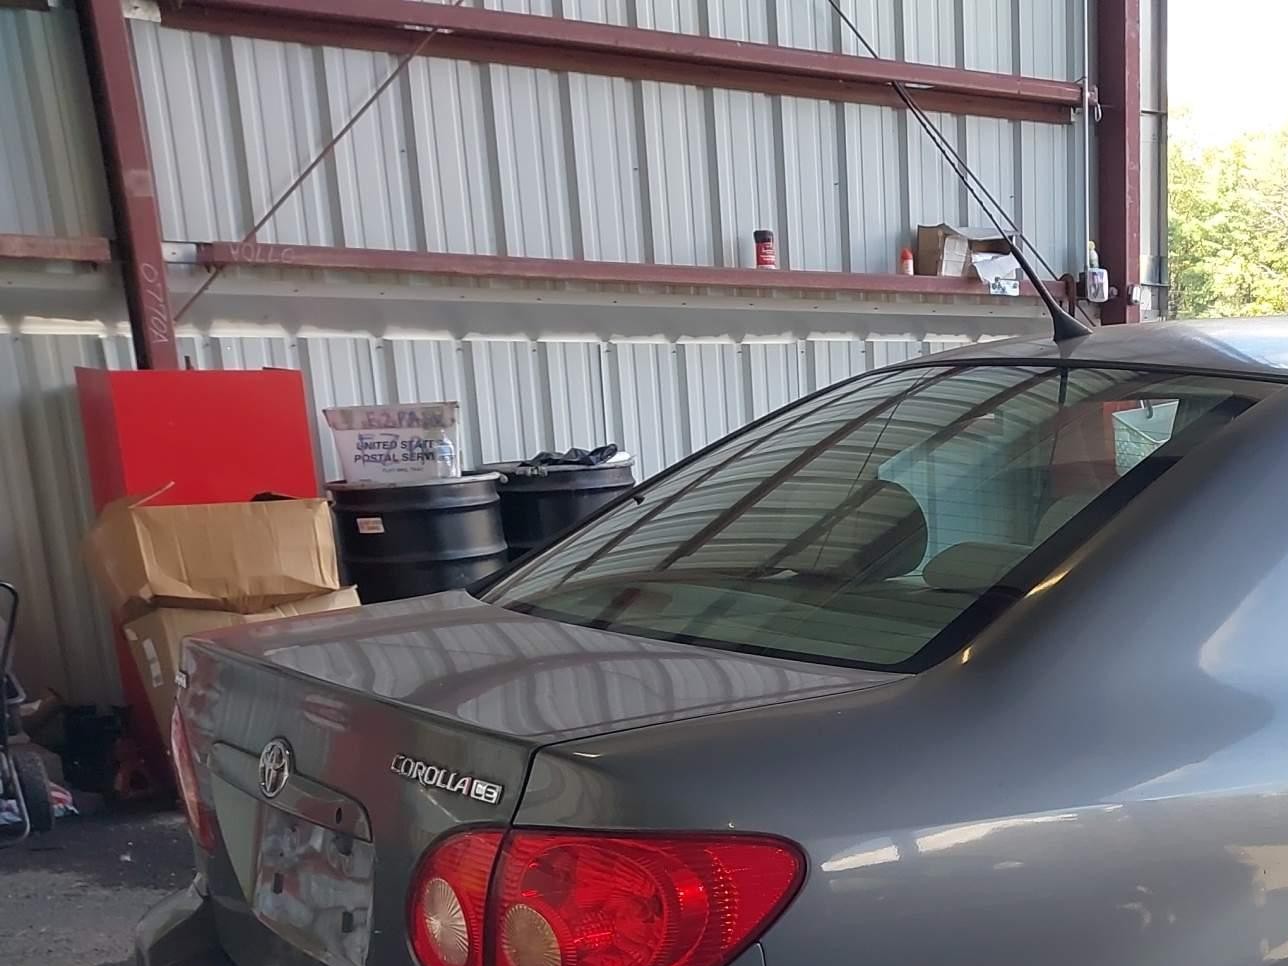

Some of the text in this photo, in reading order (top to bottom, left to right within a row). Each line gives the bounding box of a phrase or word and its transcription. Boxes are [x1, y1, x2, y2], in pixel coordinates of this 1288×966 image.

[356, 440, 398, 451] UNITED
[354, 453, 399, 463] POSTAL
[401, 452, 436, 462] SERVI
[391, 754, 472, 796] COROLLA
